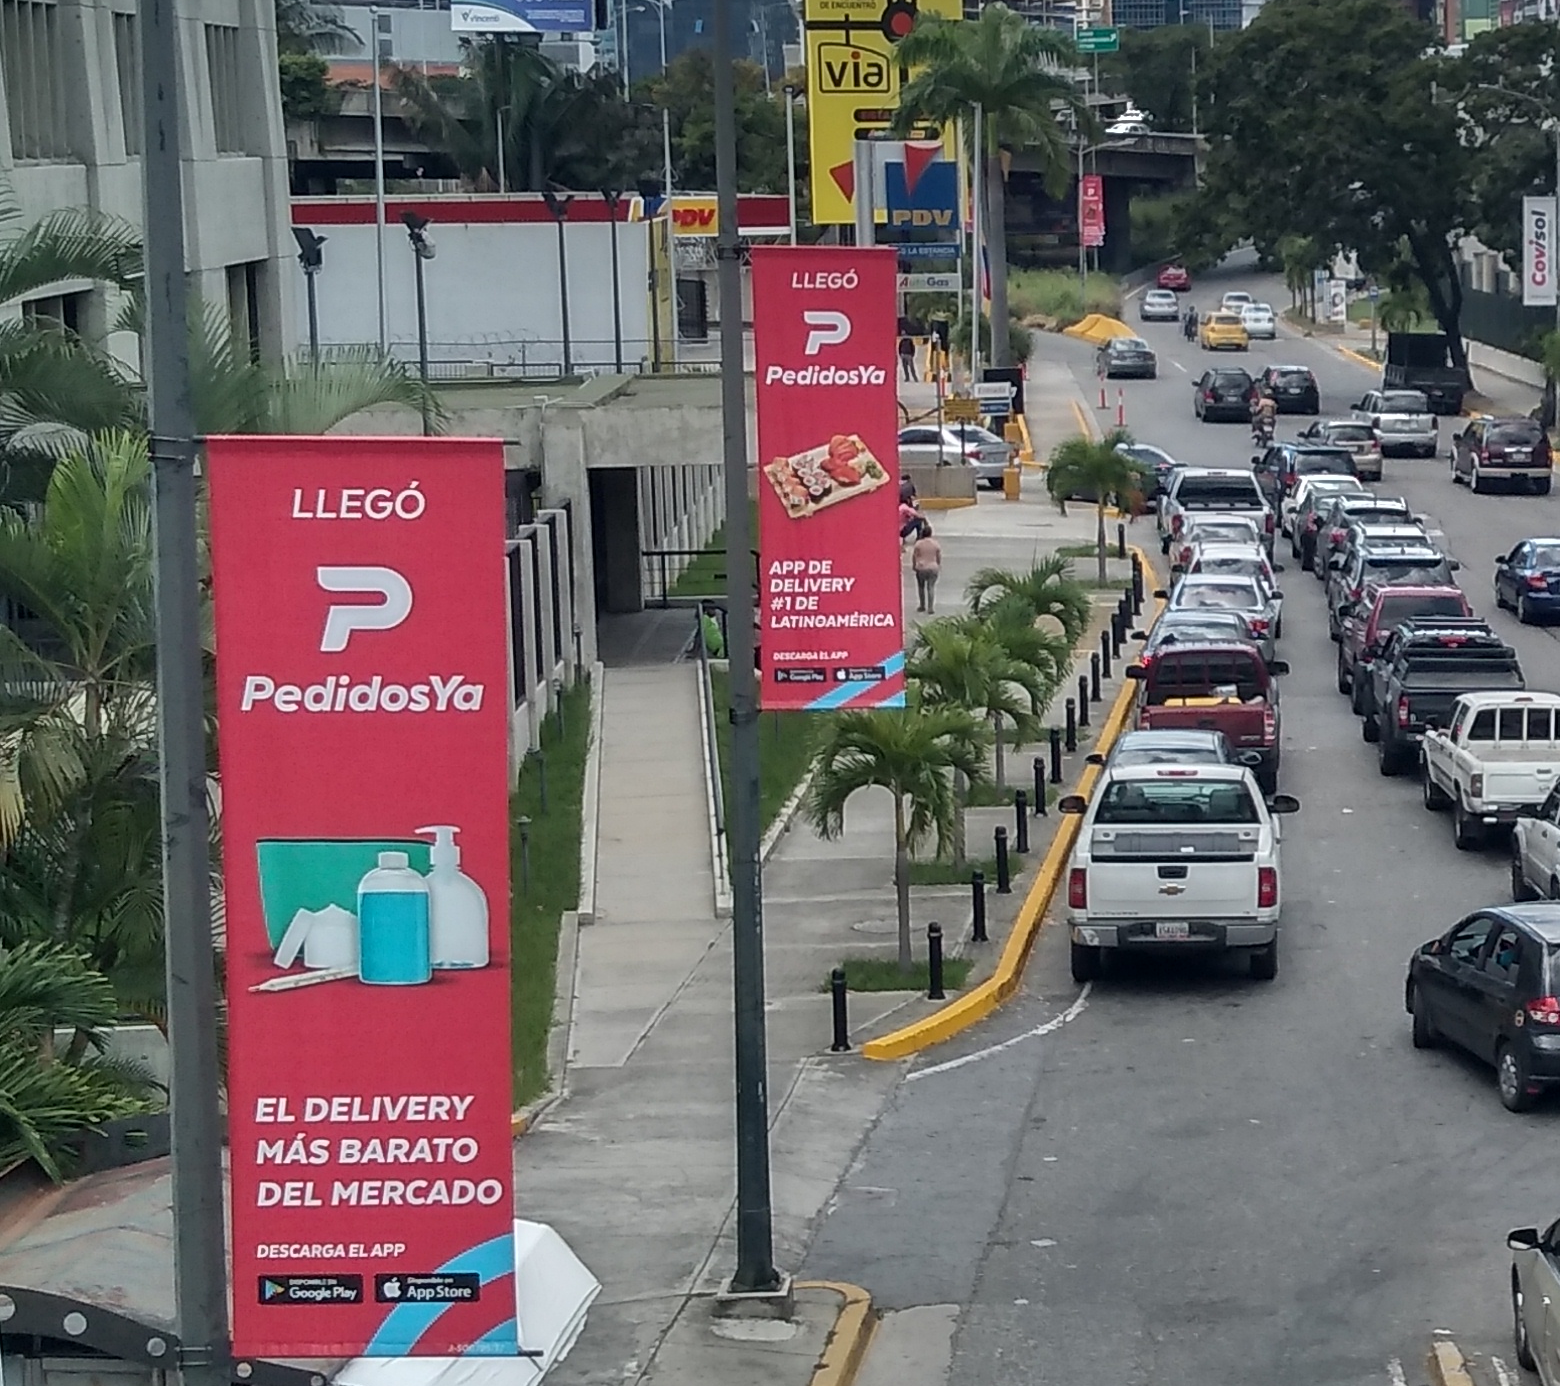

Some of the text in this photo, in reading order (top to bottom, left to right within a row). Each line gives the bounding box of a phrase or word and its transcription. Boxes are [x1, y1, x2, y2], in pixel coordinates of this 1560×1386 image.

[831, 1, 876, 9] ENCUENTRO
[892, 209, 953, 226] PDV
[1529, 210, 1546, 286] Covisol
[792, 268, 859, 289] LLEGÓ
[765, 365, 886, 386] PedidosYa
[292, 481, 426, 520] LLEGÓ
[769, 560, 833, 575] APP DE
[770, 577, 855, 592] DELIVERY
[770, 596, 819, 611] #1 DE
[771, 611, 895, 629] LATINOAMÉRICA
[773, 651, 818, 661] DESCARGA
[241, 675, 485, 713] PedidosYa
[255, 1095, 475, 1123] EL DELIVERY
[256, 1132, 479, 1164] MÁS BARATO
[257, 1179, 503, 1207] DEL MERCADO
[256, 1243, 406, 1259] DESCARGA EL APP
[289, 1286, 357, 1301] Google Play
[407, 1285, 472, 1300] App Store
